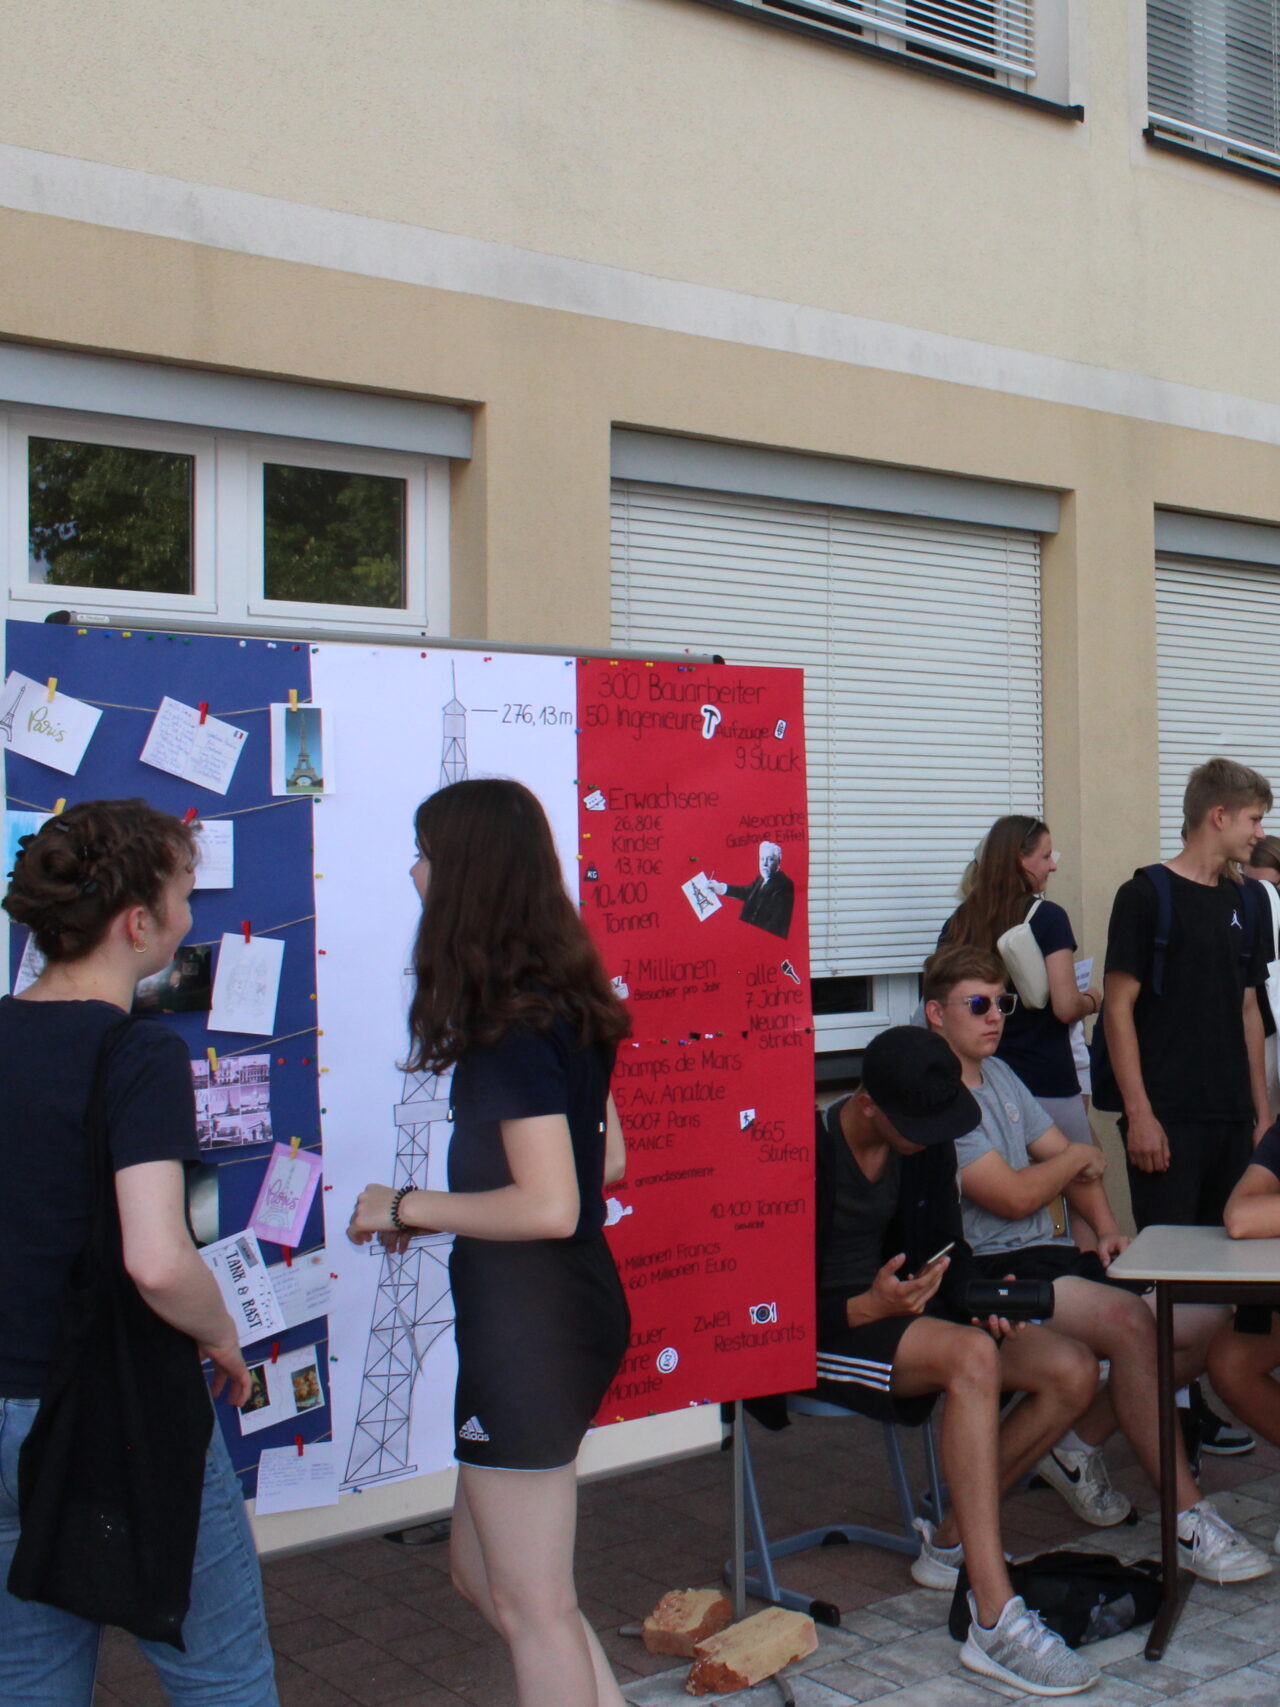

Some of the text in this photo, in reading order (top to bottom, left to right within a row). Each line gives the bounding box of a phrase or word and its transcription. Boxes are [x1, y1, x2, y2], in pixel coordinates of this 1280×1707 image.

[598, 673, 768, 704] 300 Bauarbeiter
[28, 706, 66, 742] Paris
[585, 704, 701, 740] 50 Ingenieure
[734, 746, 746, 769] 9
[608, 783, 719, 811] Erwachsene
[611, 834, 664, 854] Kinder
[603, 911, 660, 934] Tonnen
[638, 957, 716, 983] Millionen
[745, 963, 778, 988] alle
[757, 984, 804, 1009] Jahre
[675, 1052, 696, 1073] de
[702, 1051, 743, 1071] Mars
[668, 1110, 701, 1129] Paris
[757, 1142, 810, 1164] Stufen
[757, 1198, 806, 1216] Tonnen
[704, 1257, 737, 1275] Euro
[225, 1250, 247, 1285] TANK
[242, 1297, 264, 1329] RAST
[693, 1310, 731, 1334] Zwei
[630, 1327, 667, 1349] auer
[713, 1322, 807, 1353] Restaurants
[459, 1430, 490, 1441] adidas
